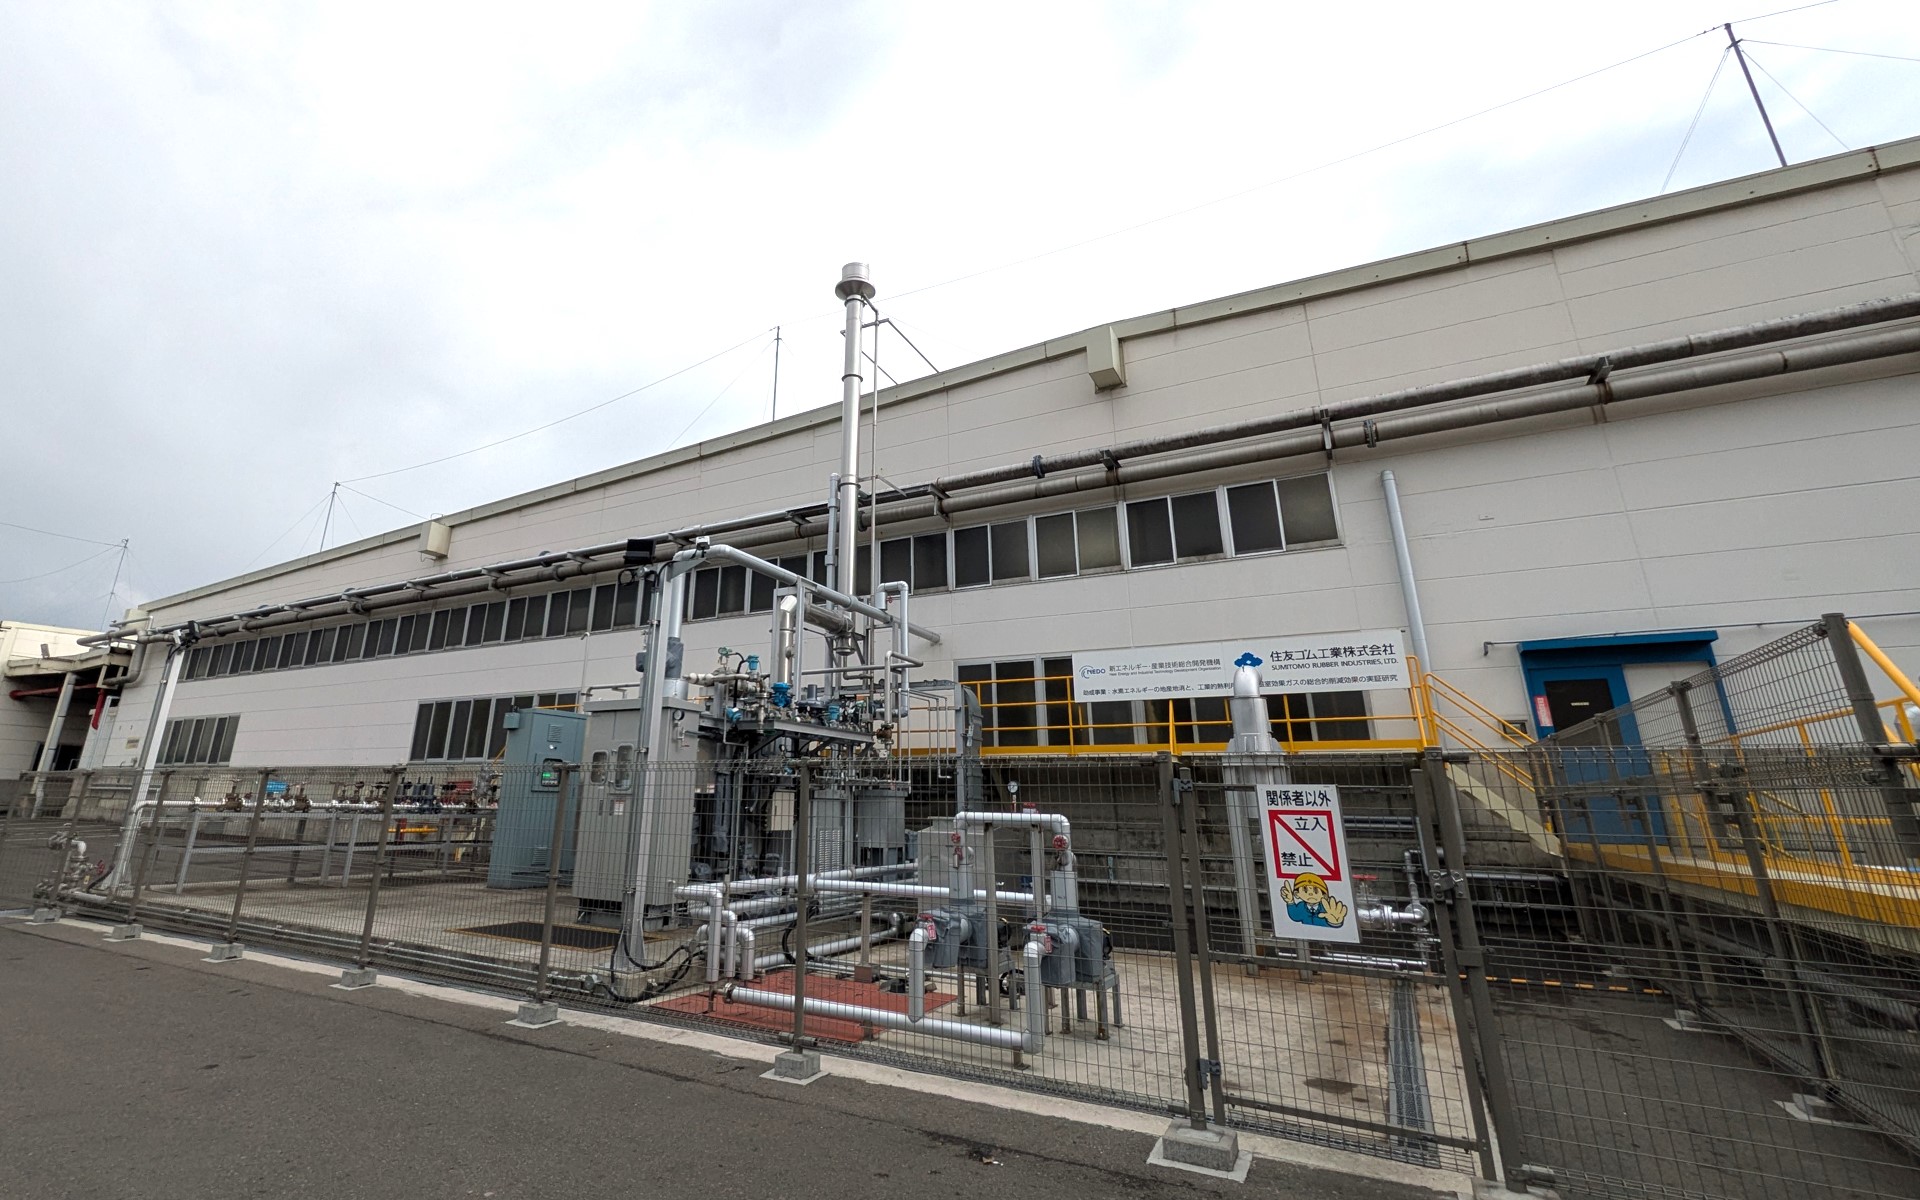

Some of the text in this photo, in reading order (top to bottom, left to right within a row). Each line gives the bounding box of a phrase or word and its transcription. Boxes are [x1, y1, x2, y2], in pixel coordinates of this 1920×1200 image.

[1270, 643, 1396, 662] 住友ゴム工業株式会社
[1109, 658, 1221, 672] 新エネルギー・産業技術総合開発機構
[1271, 663, 1310, 671] SUMITOMO
[1312, 661, 1339, 669] RUBBER
[1341, 659, 1383, 667] INDUSTRIES,
[1266, 790, 1331, 807] 関係者以外
[1294, 816, 1327, 832] 立入
[1281, 851, 1314, 867] 禁止
